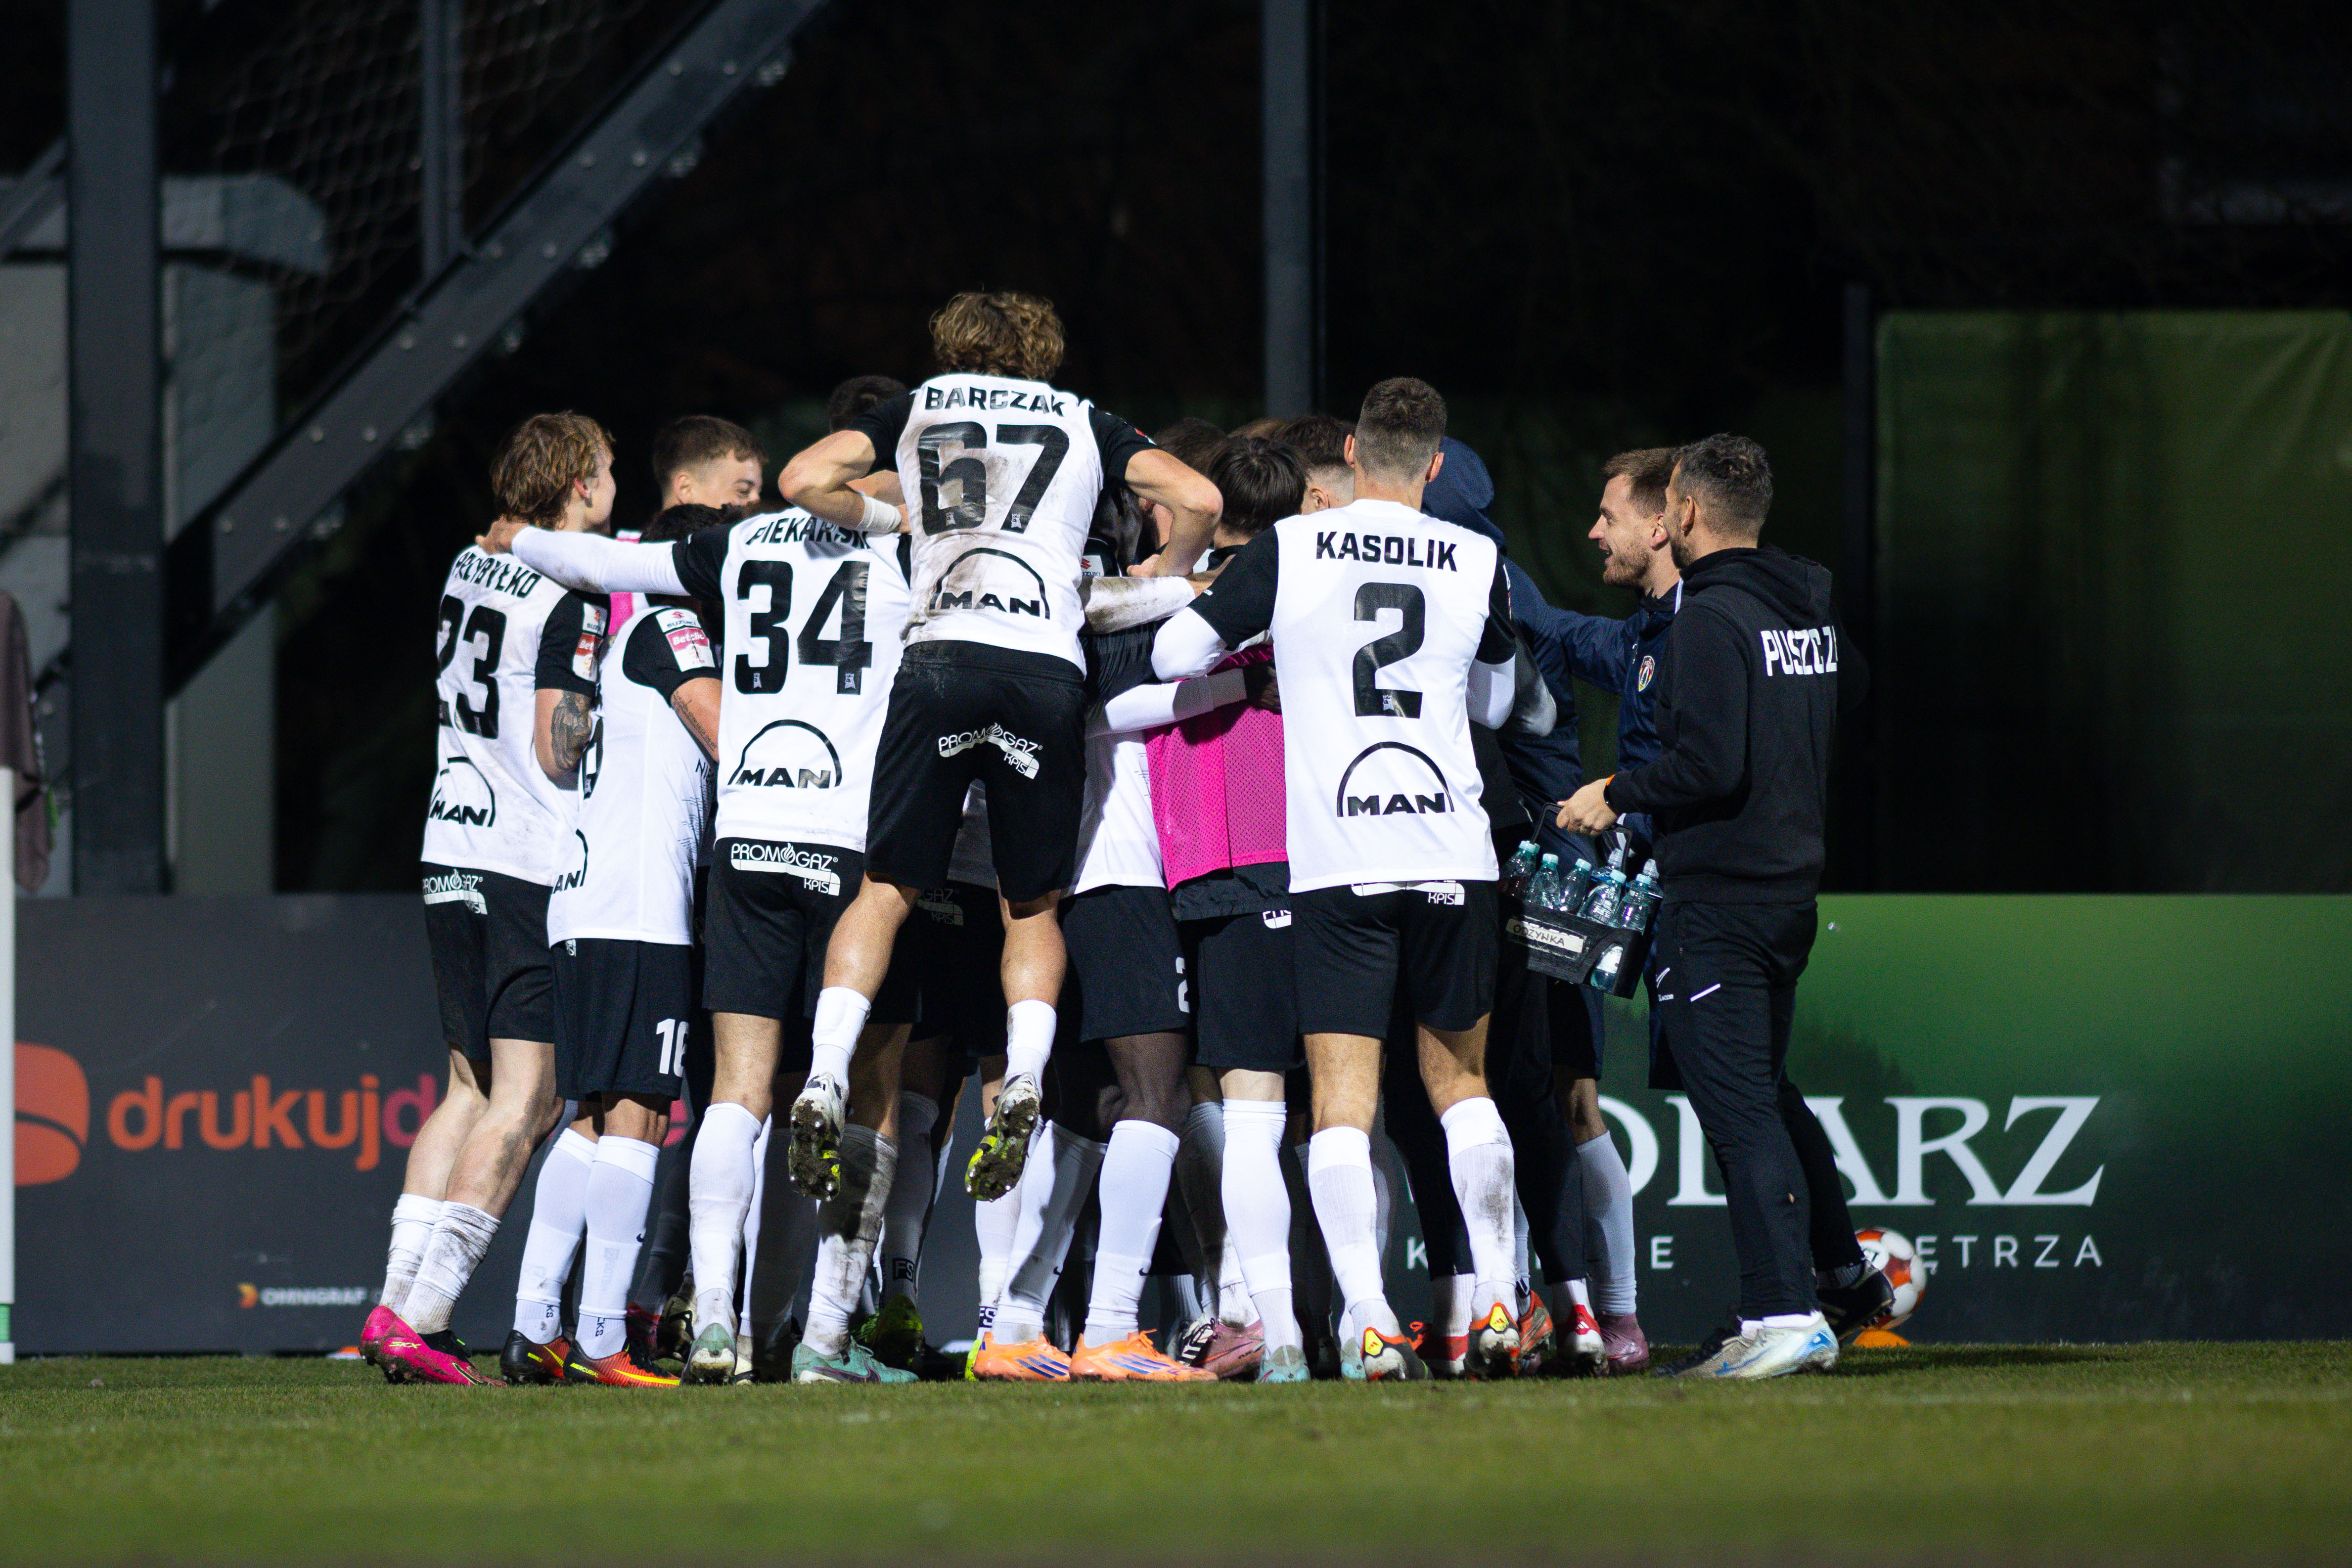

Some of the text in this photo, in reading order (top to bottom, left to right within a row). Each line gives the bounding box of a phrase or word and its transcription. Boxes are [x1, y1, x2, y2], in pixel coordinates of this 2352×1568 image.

[924, 386, 1066, 416] BARCZAK
[917, 421, 1070, 537] 67
[745, 517, 871, 549] PIEKARSK
[1316, 531, 1457, 573] KASOLIK
[941, 590, 1040, 617] MAN
[734, 559, 873, 695] 34
[1353, 582, 1426, 719] 2
[1761, 626, 1838, 676] PUSZCZ
[1004, 752, 1026, 774] KPIS
[735, 767, 831, 789] MAN
[429, 800, 489, 827] MAN
[1347, 793, 1446, 816] MAN
[552, 870, 582, 894] AN
[804, 878, 829, 894] KPIS
[1428, 892, 1455, 905] KPIS
[1915, 1235, 2103, 1275] ĘTRZA
